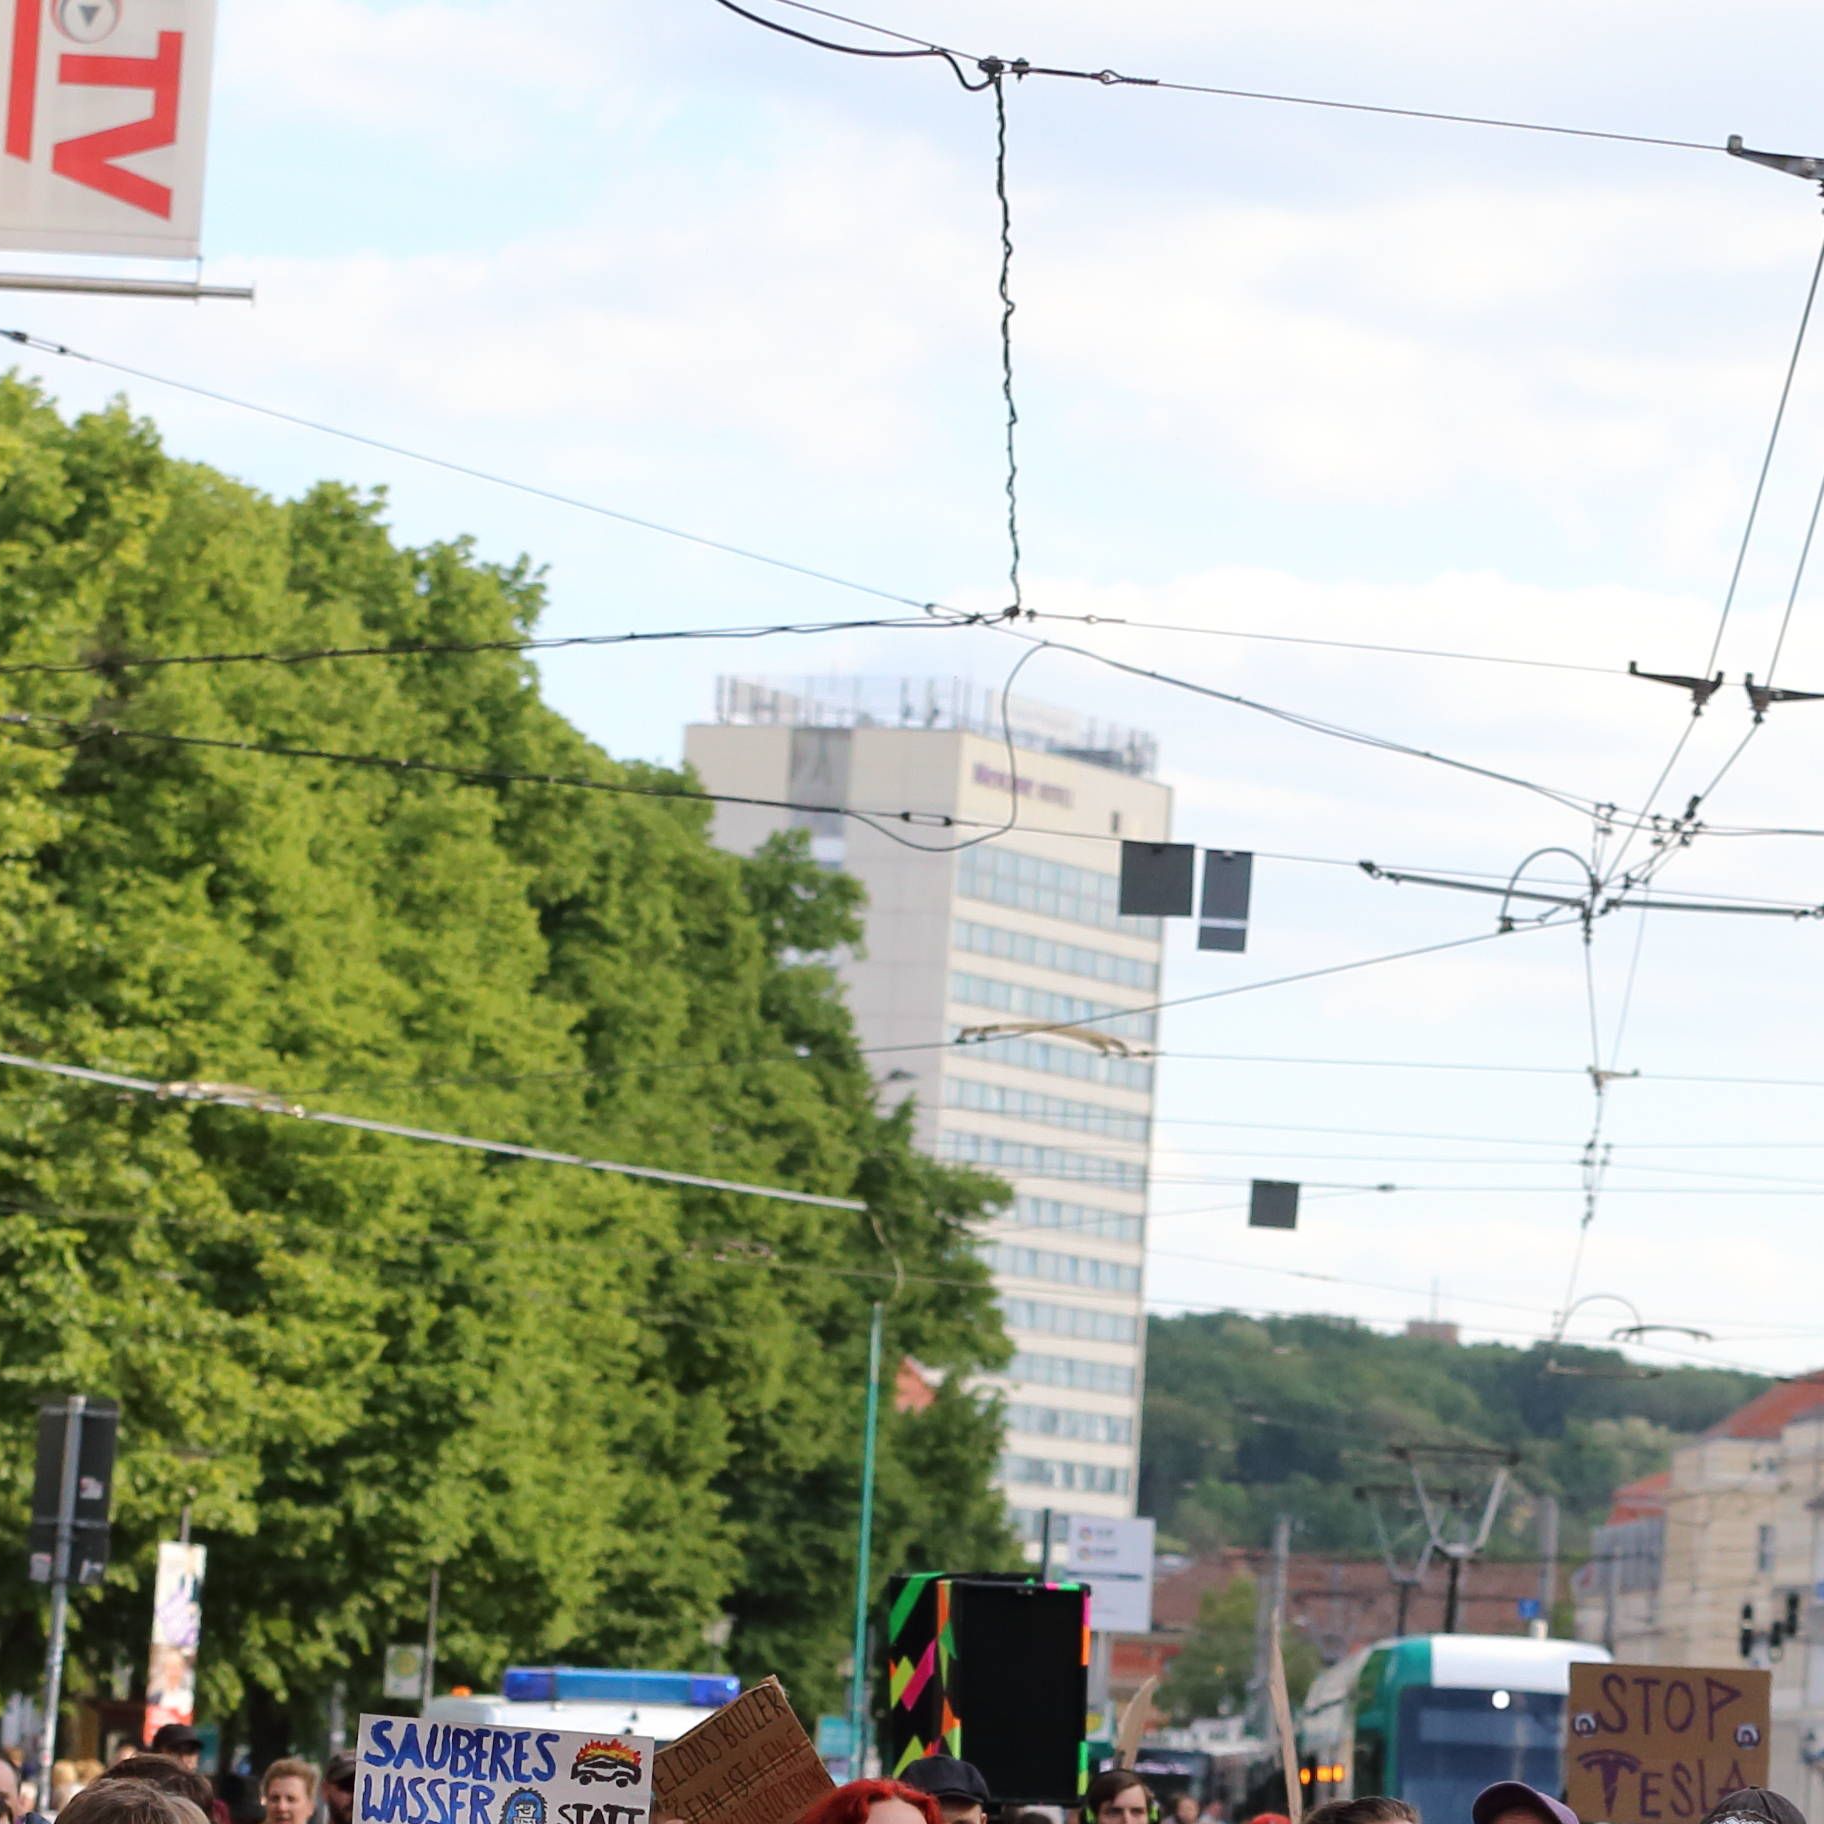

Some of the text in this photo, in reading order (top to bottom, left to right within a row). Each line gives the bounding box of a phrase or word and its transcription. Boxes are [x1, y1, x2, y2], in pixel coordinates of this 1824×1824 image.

[50, 30, 185, 222] TV
[1597, 1672, 1743, 1742] STOP
[364, 1720, 560, 1784] SAUBERES
[653, 1729, 724, 1797] ELONS
[1577, 1749, 1747, 1818] TESLA
